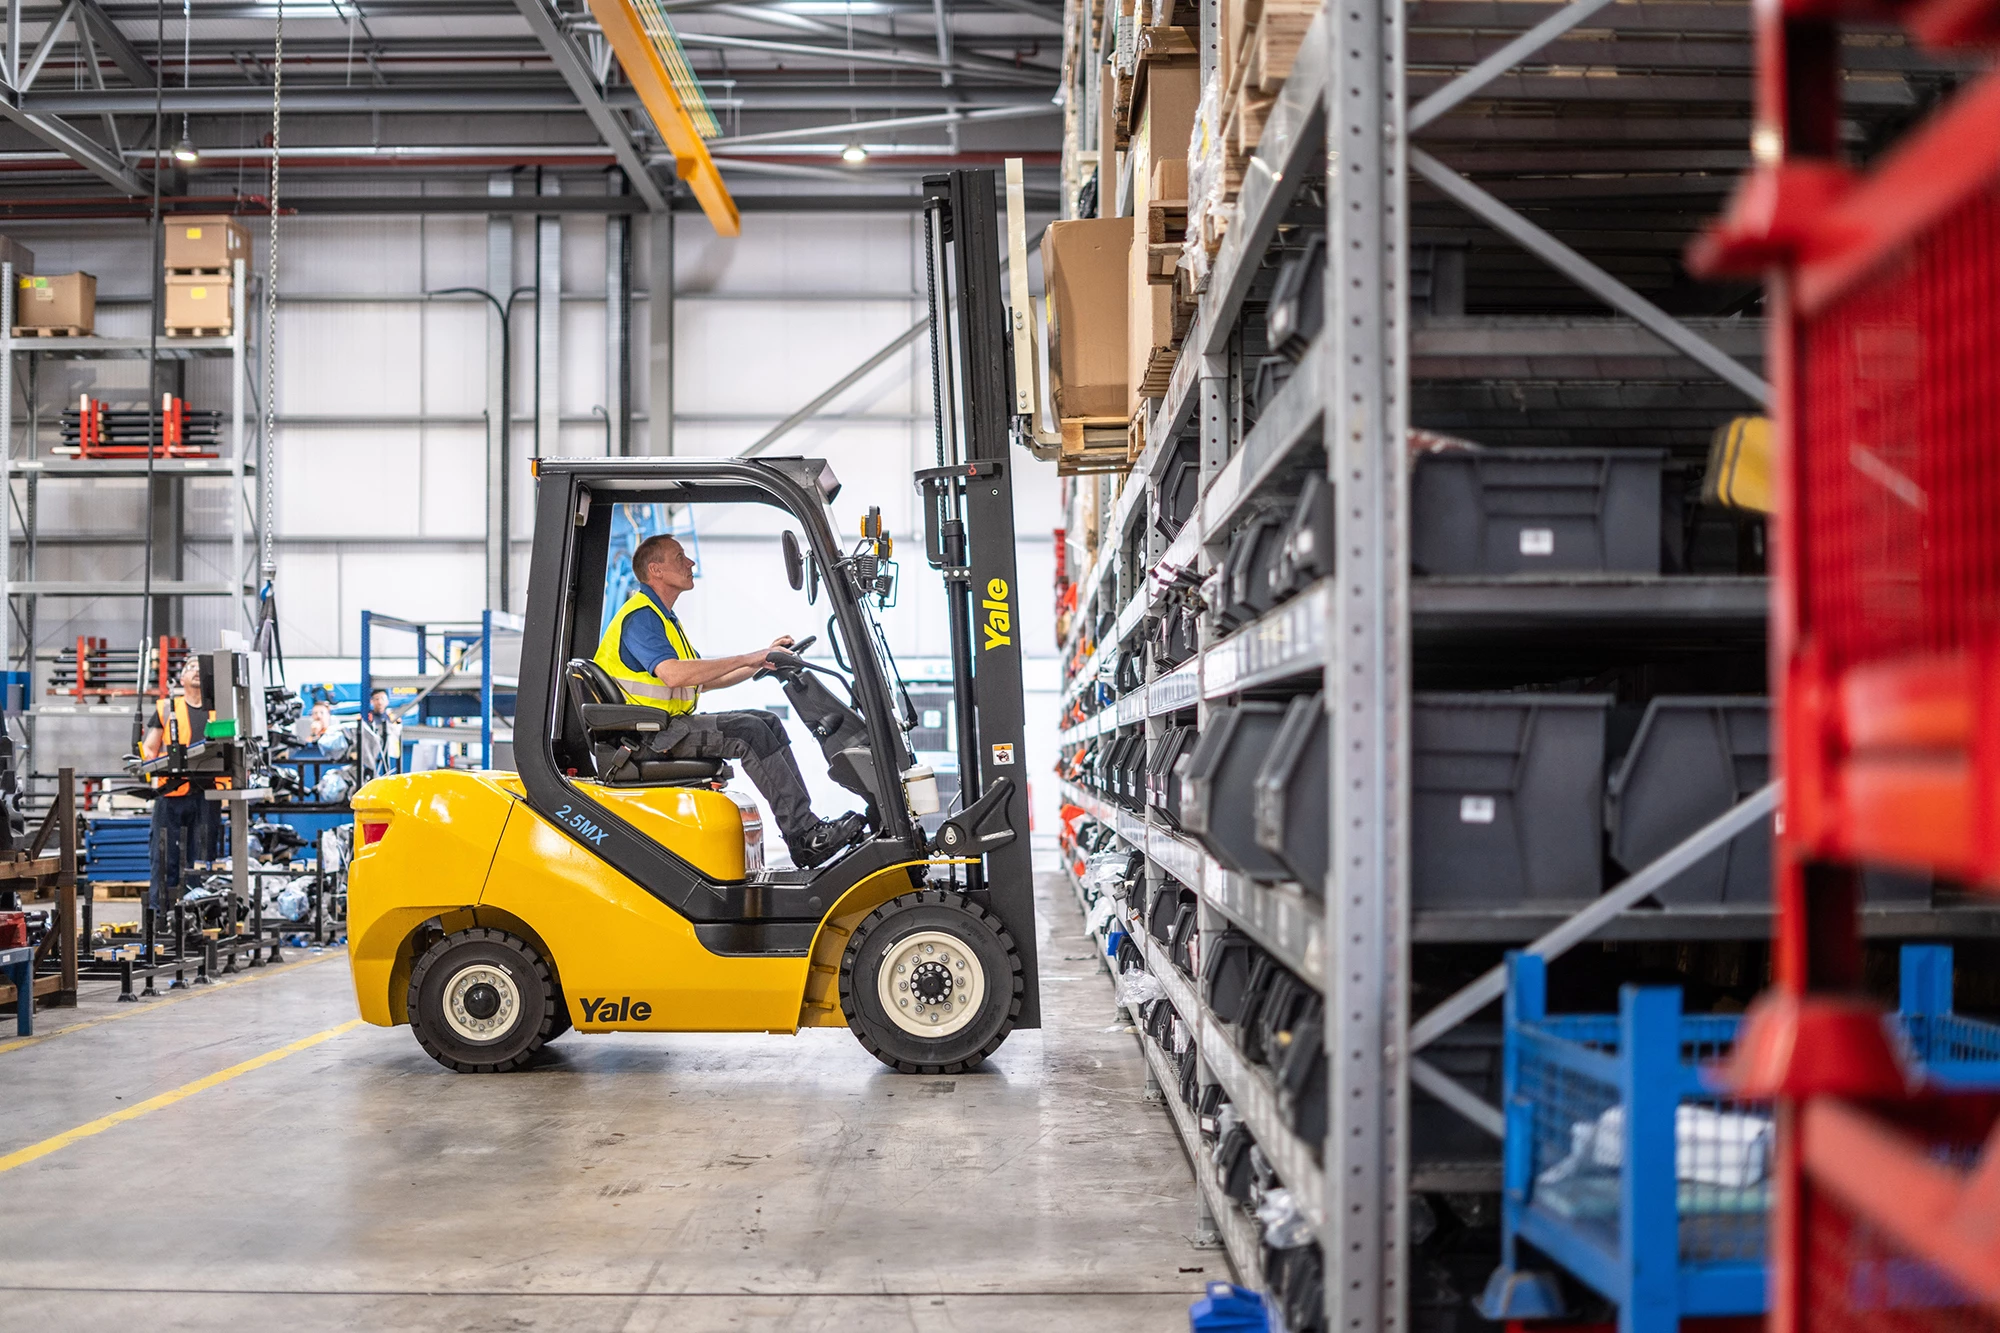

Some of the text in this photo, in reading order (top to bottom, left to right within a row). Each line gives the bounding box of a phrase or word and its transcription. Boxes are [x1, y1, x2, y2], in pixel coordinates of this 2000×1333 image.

[982, 578, 1011, 651] Yale
[555, 804, 609, 846] 2.5MX
[579, 996, 652, 1022] Yale
